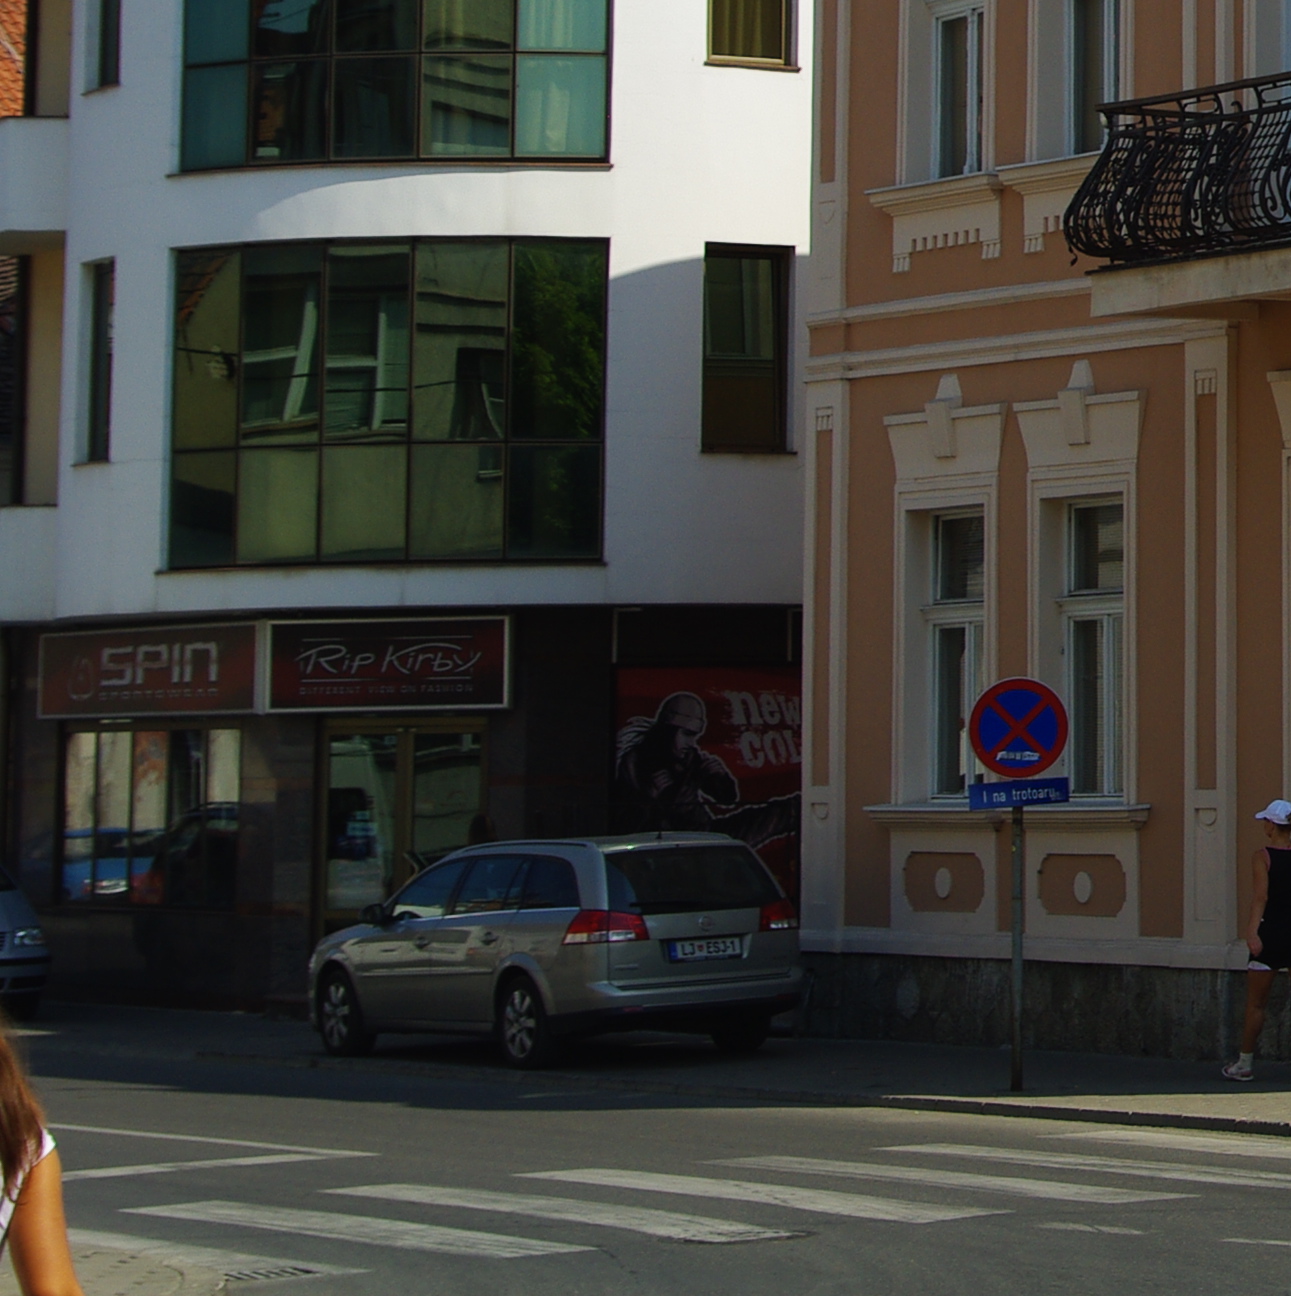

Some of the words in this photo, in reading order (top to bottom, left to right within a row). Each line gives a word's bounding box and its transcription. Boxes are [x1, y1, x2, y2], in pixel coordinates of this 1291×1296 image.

[99, 642, 218, 686] SPIN
[298, 685, 361, 696] DIFFERENT
[367, 684, 396, 695] VIEW
[399, 684, 417, 694] ON
[420, 683, 475, 694] FASHION
[992, 792, 1006, 803] na
[1012, 787, 1056, 801] trotoaru
[681, 942, 696, 956] LJ
